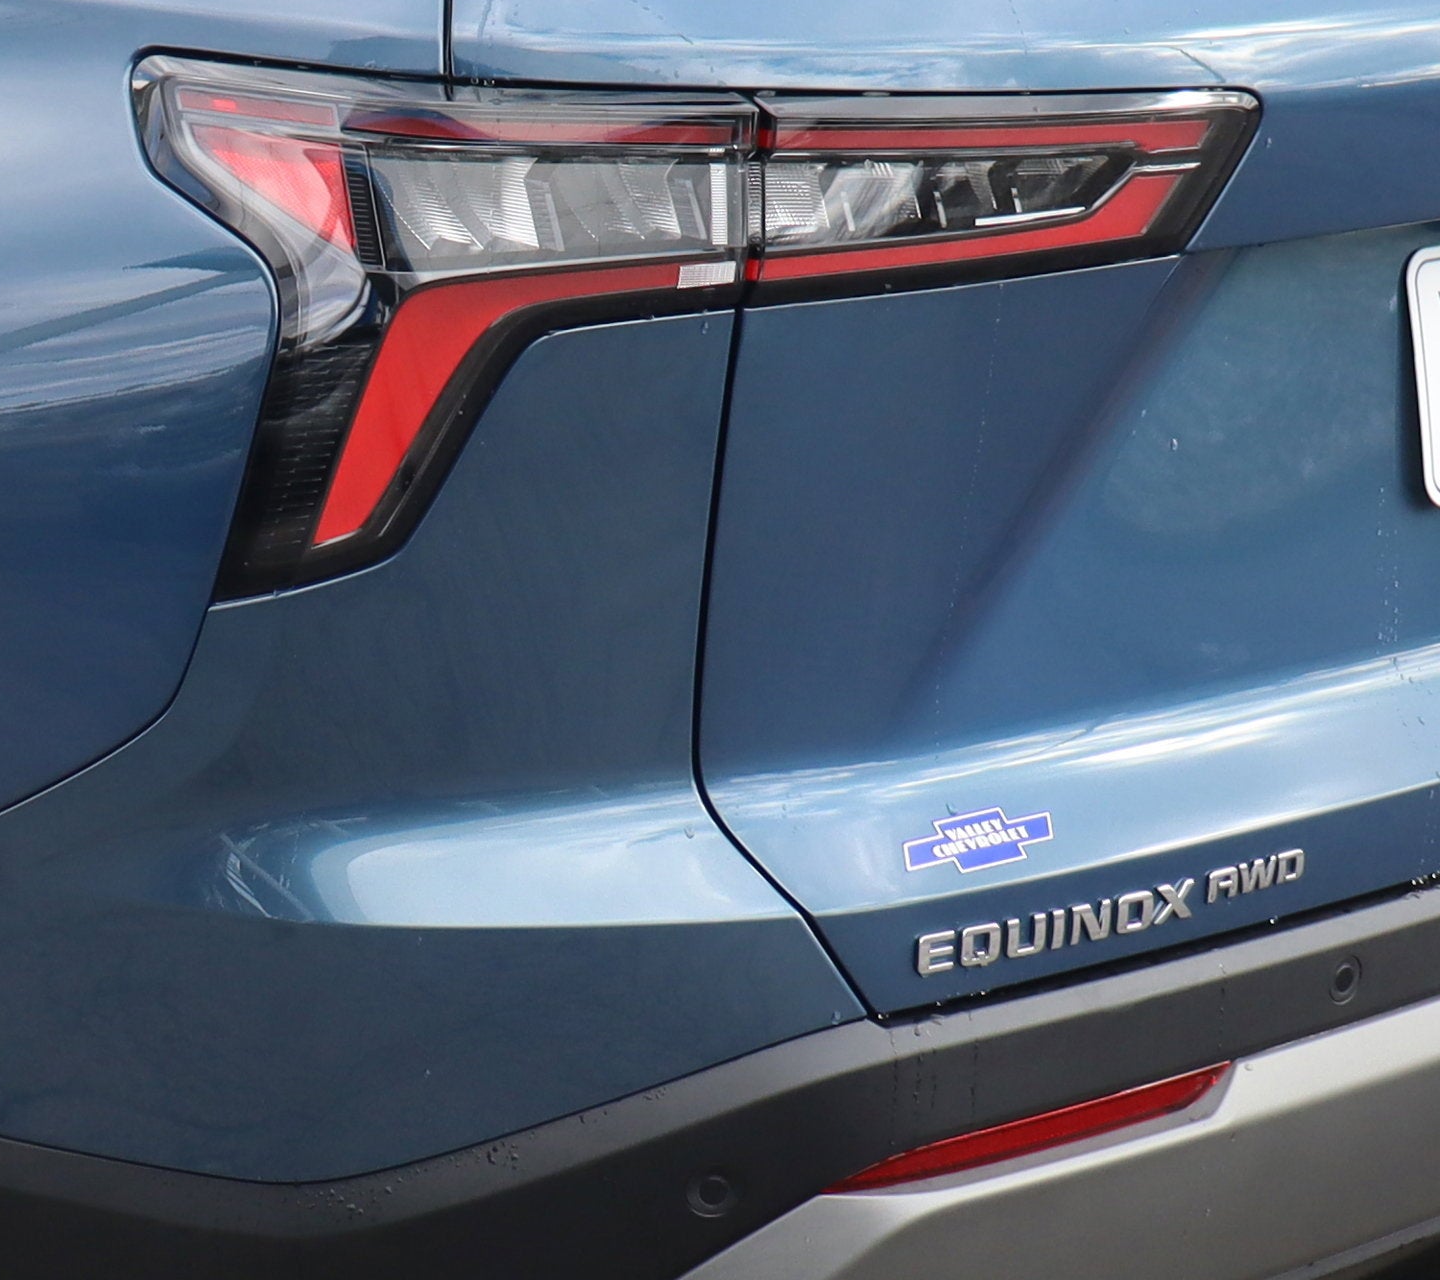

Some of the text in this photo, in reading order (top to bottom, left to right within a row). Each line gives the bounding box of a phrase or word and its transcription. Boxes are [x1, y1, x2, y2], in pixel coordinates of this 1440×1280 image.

[932, 825, 1029, 859] CHEVROLET
[944, 817, 1004, 842] VALLEY
[915, 848, 1305, 978] EQUINOX AWD
